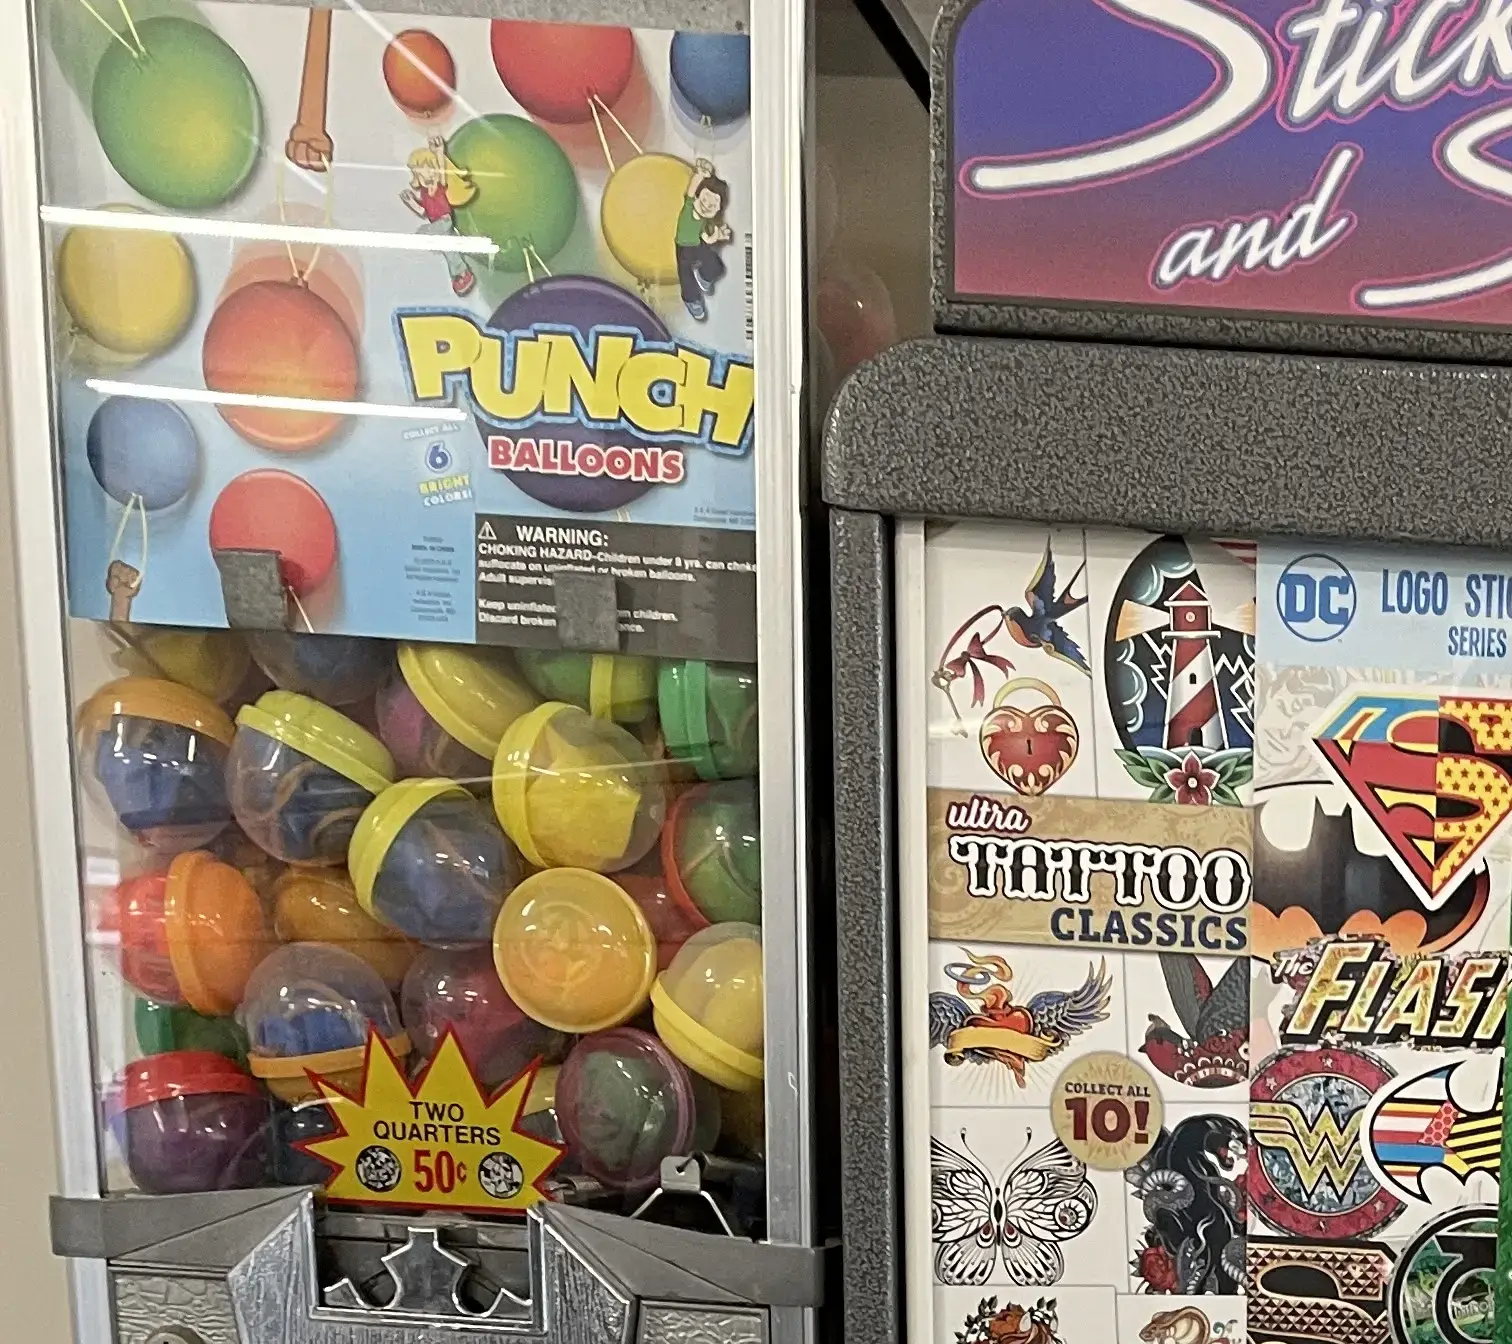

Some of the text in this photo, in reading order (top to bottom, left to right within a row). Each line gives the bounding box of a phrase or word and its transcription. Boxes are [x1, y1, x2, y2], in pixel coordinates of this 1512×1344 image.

[1161, 150, 1353, 283] and
[400, 314, 755, 447] PUNCH
[427, 441, 451, 472] 6
[490, 437, 683, 483] BALLOONS
[419, 475, 470, 494] BRIGHT
[516, 525, 609, 547] WARNING:
[479, 543, 537, 558] CHOKING
[706, 560, 725, 570] can
[1281, 573, 1352, 626] DC
[1381, 568, 1449, 617] LOGO
[1447, 626, 1508, 659] SERIES
[948, 798, 1029, 832] ultra
[950, 836, 1250, 912] TATTOO
[1050, 906, 1248, 950] CLASSICS
[1275, 956, 1314, 982] The
[1064, 1081, 1151, 1098] COLLECT ALL
[409, 1101, 464, 1122] TWO
[1066, 1097, 1149, 1145] 10!
[373, 1121, 501, 1146] QUARTERS
[413, 1149, 467, 1194] 50¢
